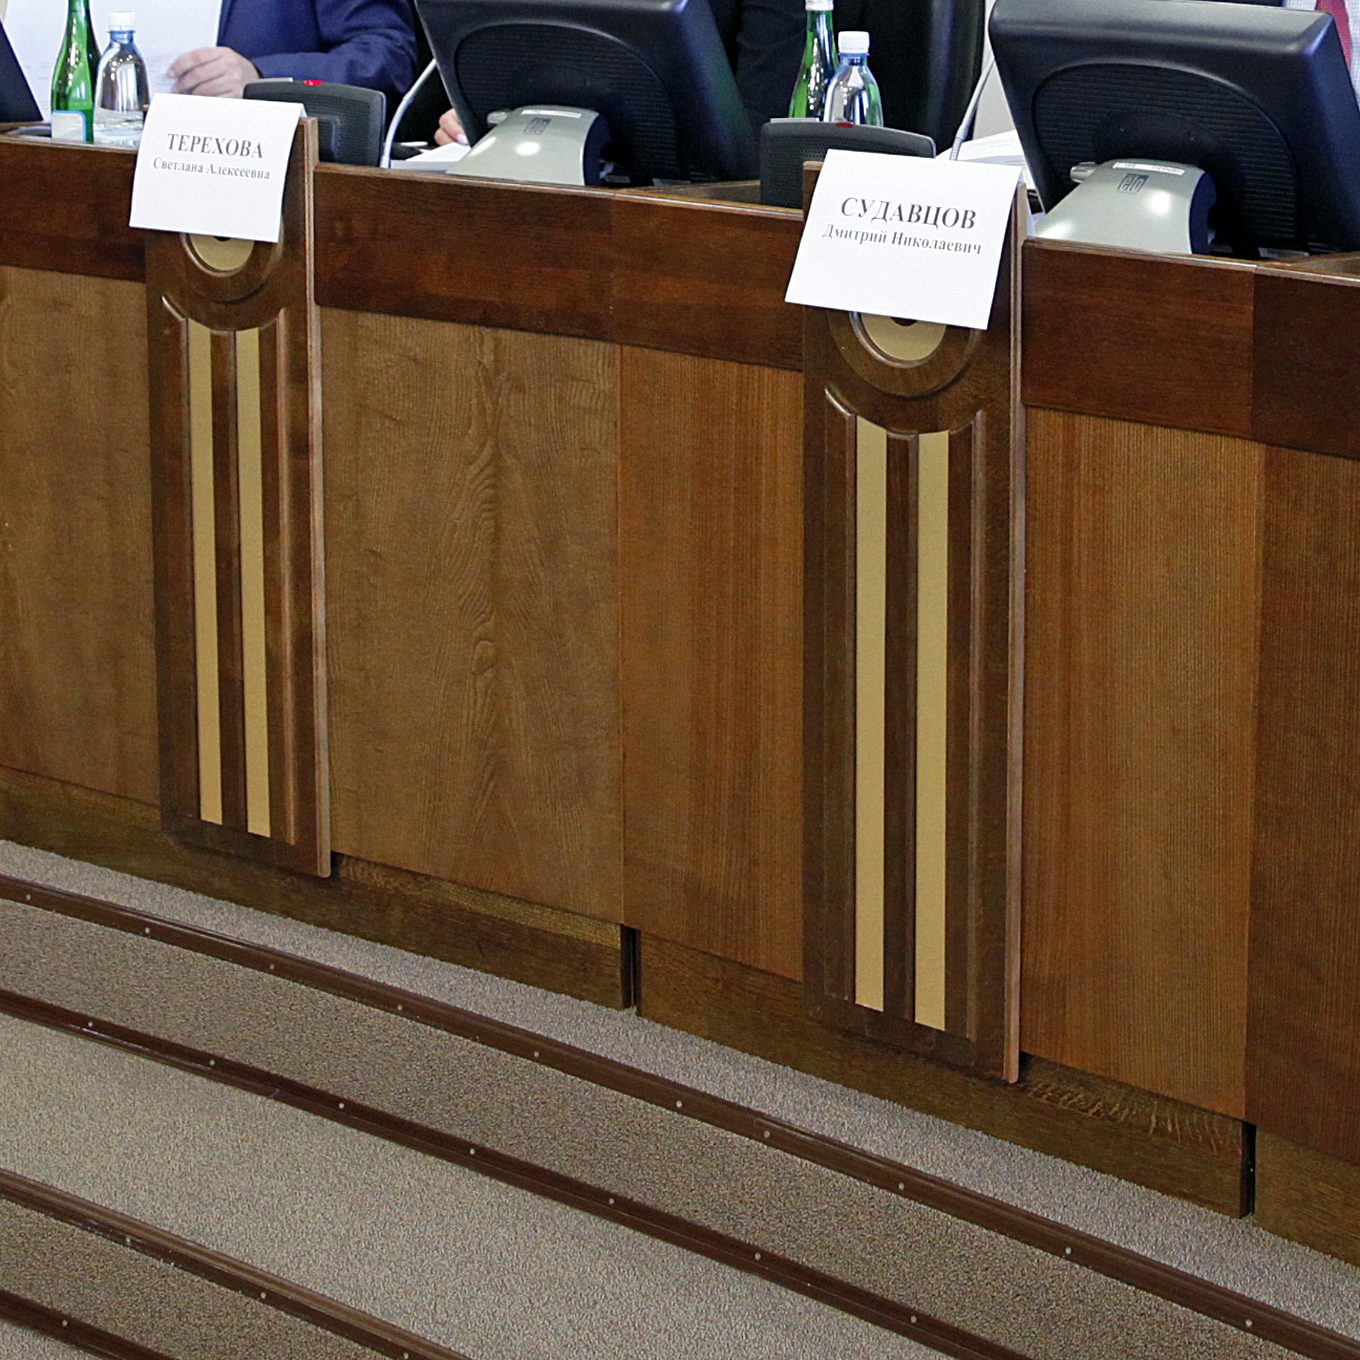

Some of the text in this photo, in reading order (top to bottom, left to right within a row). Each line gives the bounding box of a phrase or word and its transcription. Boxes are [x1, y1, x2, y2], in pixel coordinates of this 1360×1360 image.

[167, 133, 264, 159] ТЕРЕХОВА
[153, 157, 271, 180] Светлана Алексеевна
[840, 197, 977, 230] СУДАВЦОВ
[821, 223, 982, 255] Дмитрий Николаевич
